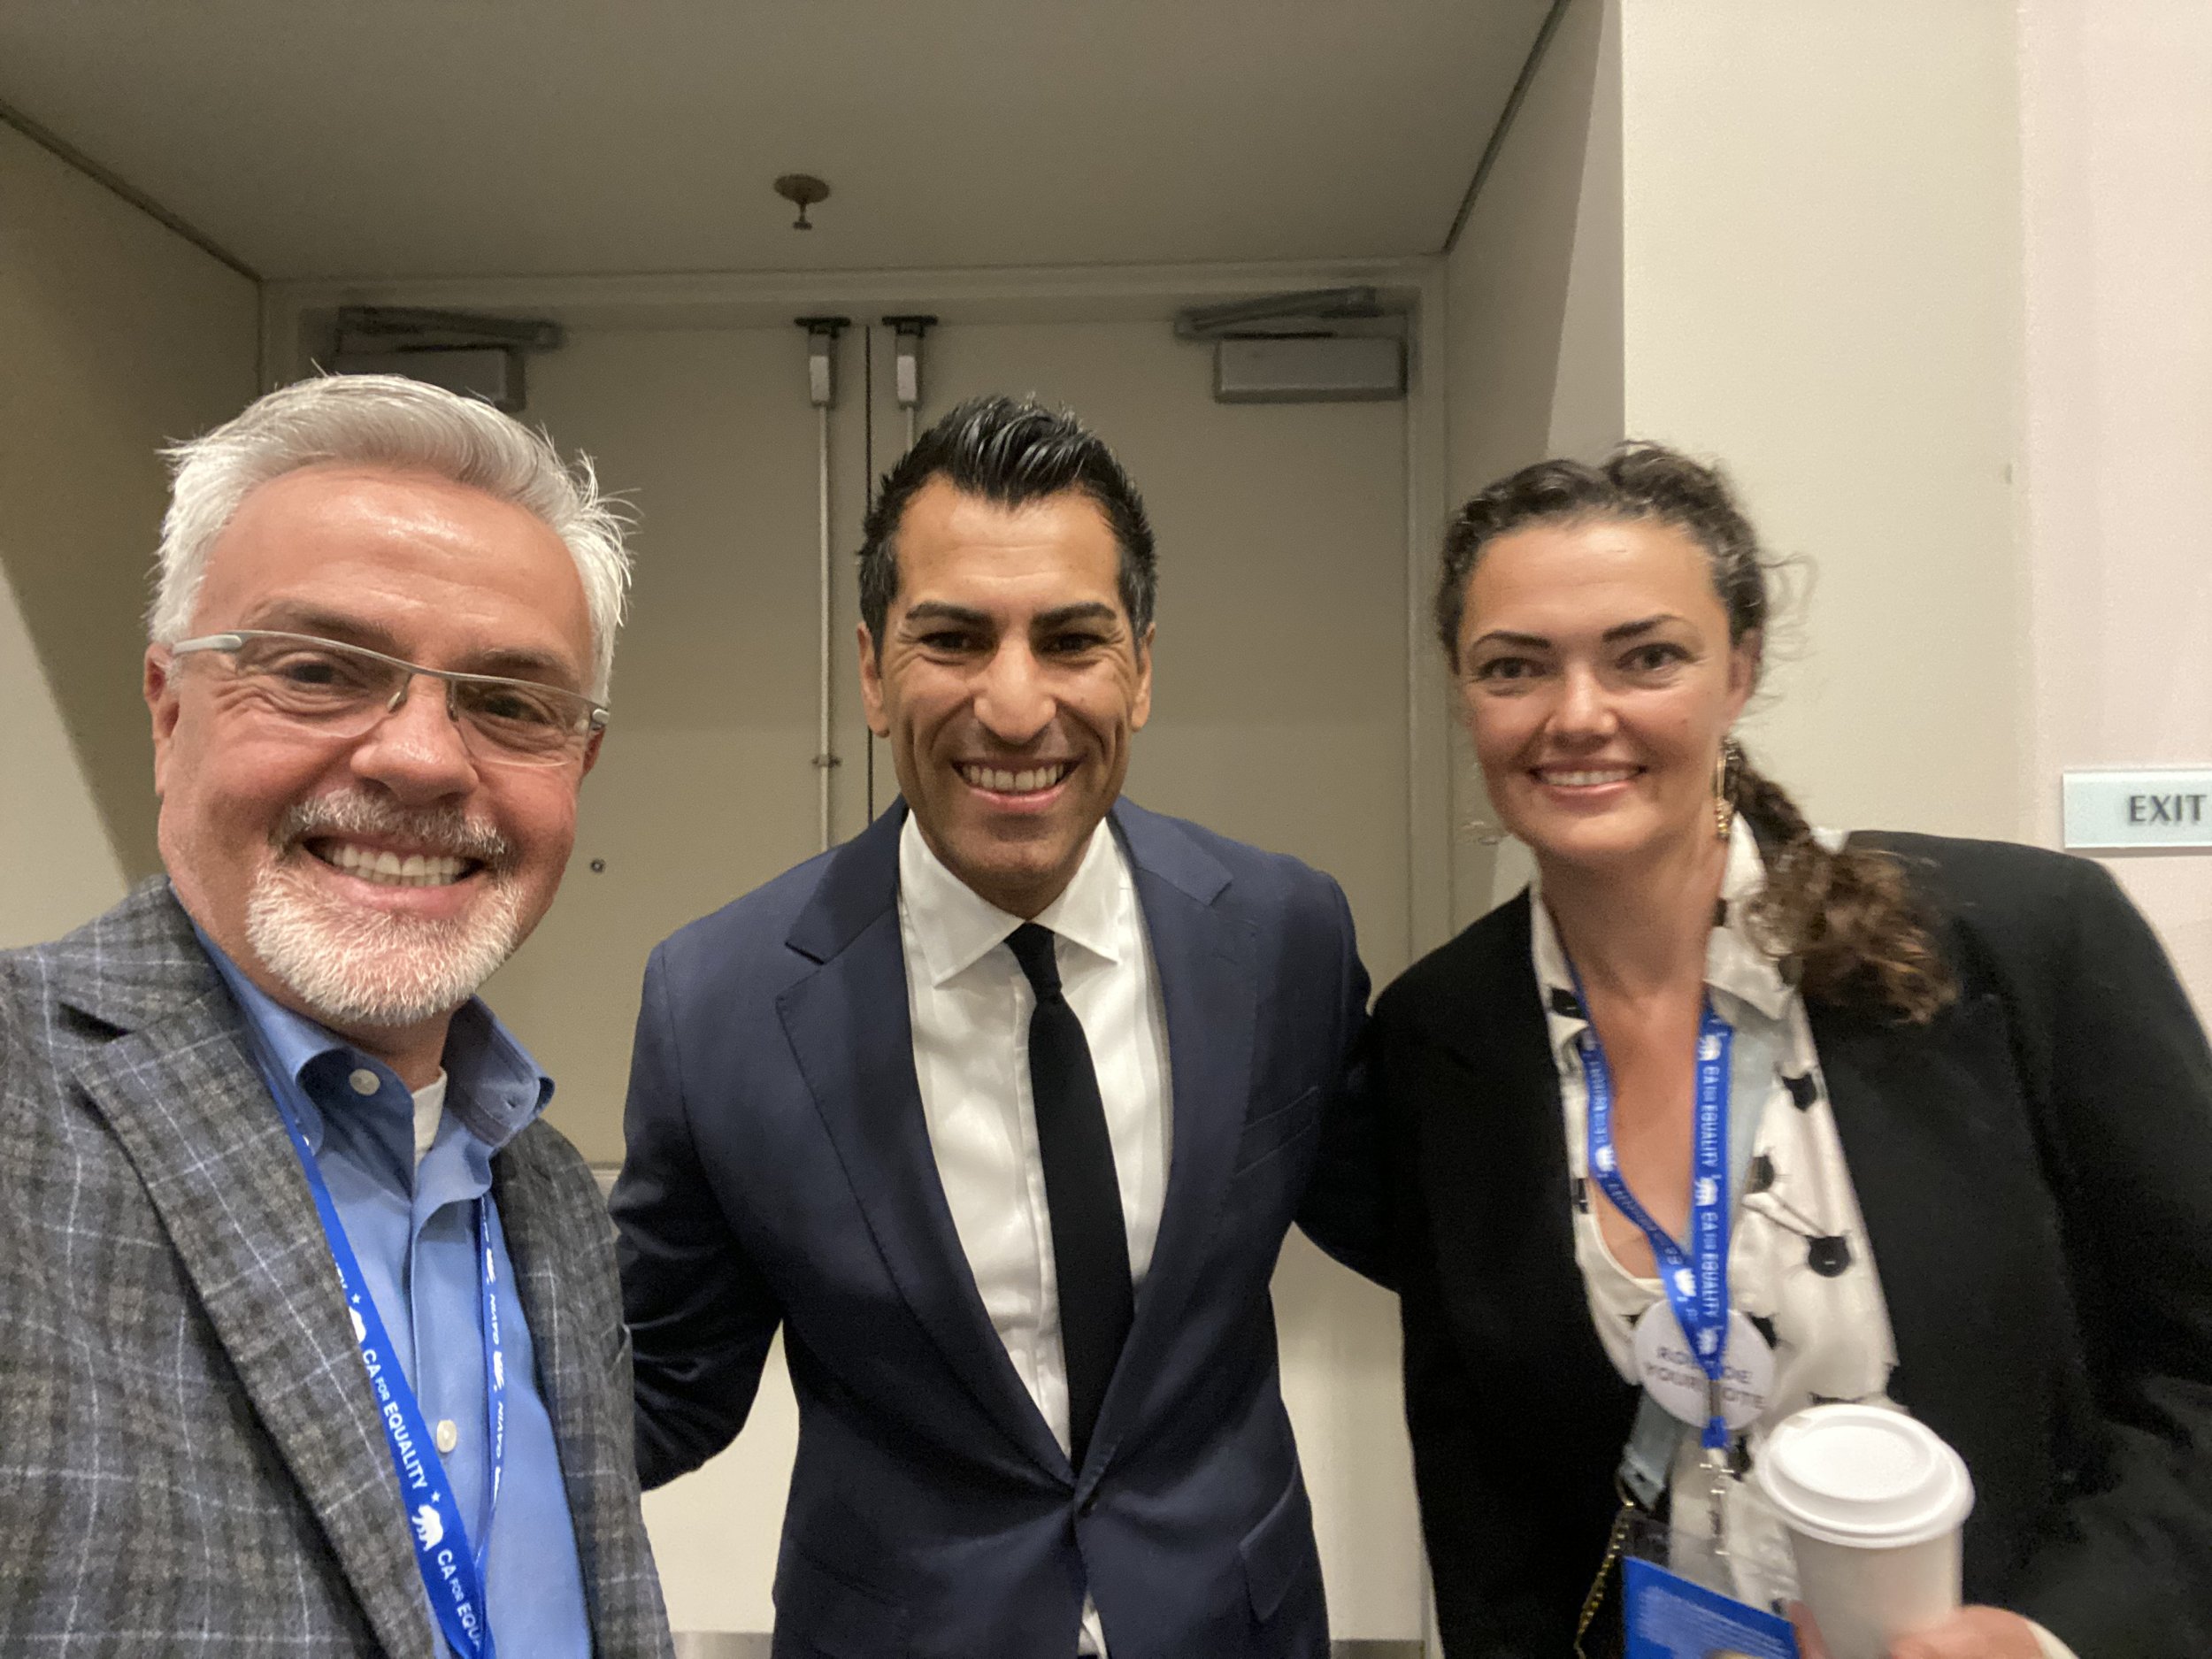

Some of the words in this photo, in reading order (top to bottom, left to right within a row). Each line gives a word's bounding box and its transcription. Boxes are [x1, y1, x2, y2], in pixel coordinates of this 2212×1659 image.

[2129, 795, 2208, 823] EXIT
[1700, 1104, 1718, 1168] EQUALITY
[1701, 1253, 1719, 1317] EQUALITY
[363, 1348, 381, 1379] CA
[375, 1376, 391, 1402] FOR
[383, 1401, 428, 1490] EQUALITY
[437, 1548, 457, 1580] CA
[449, 1578, 465, 1602] FOR
